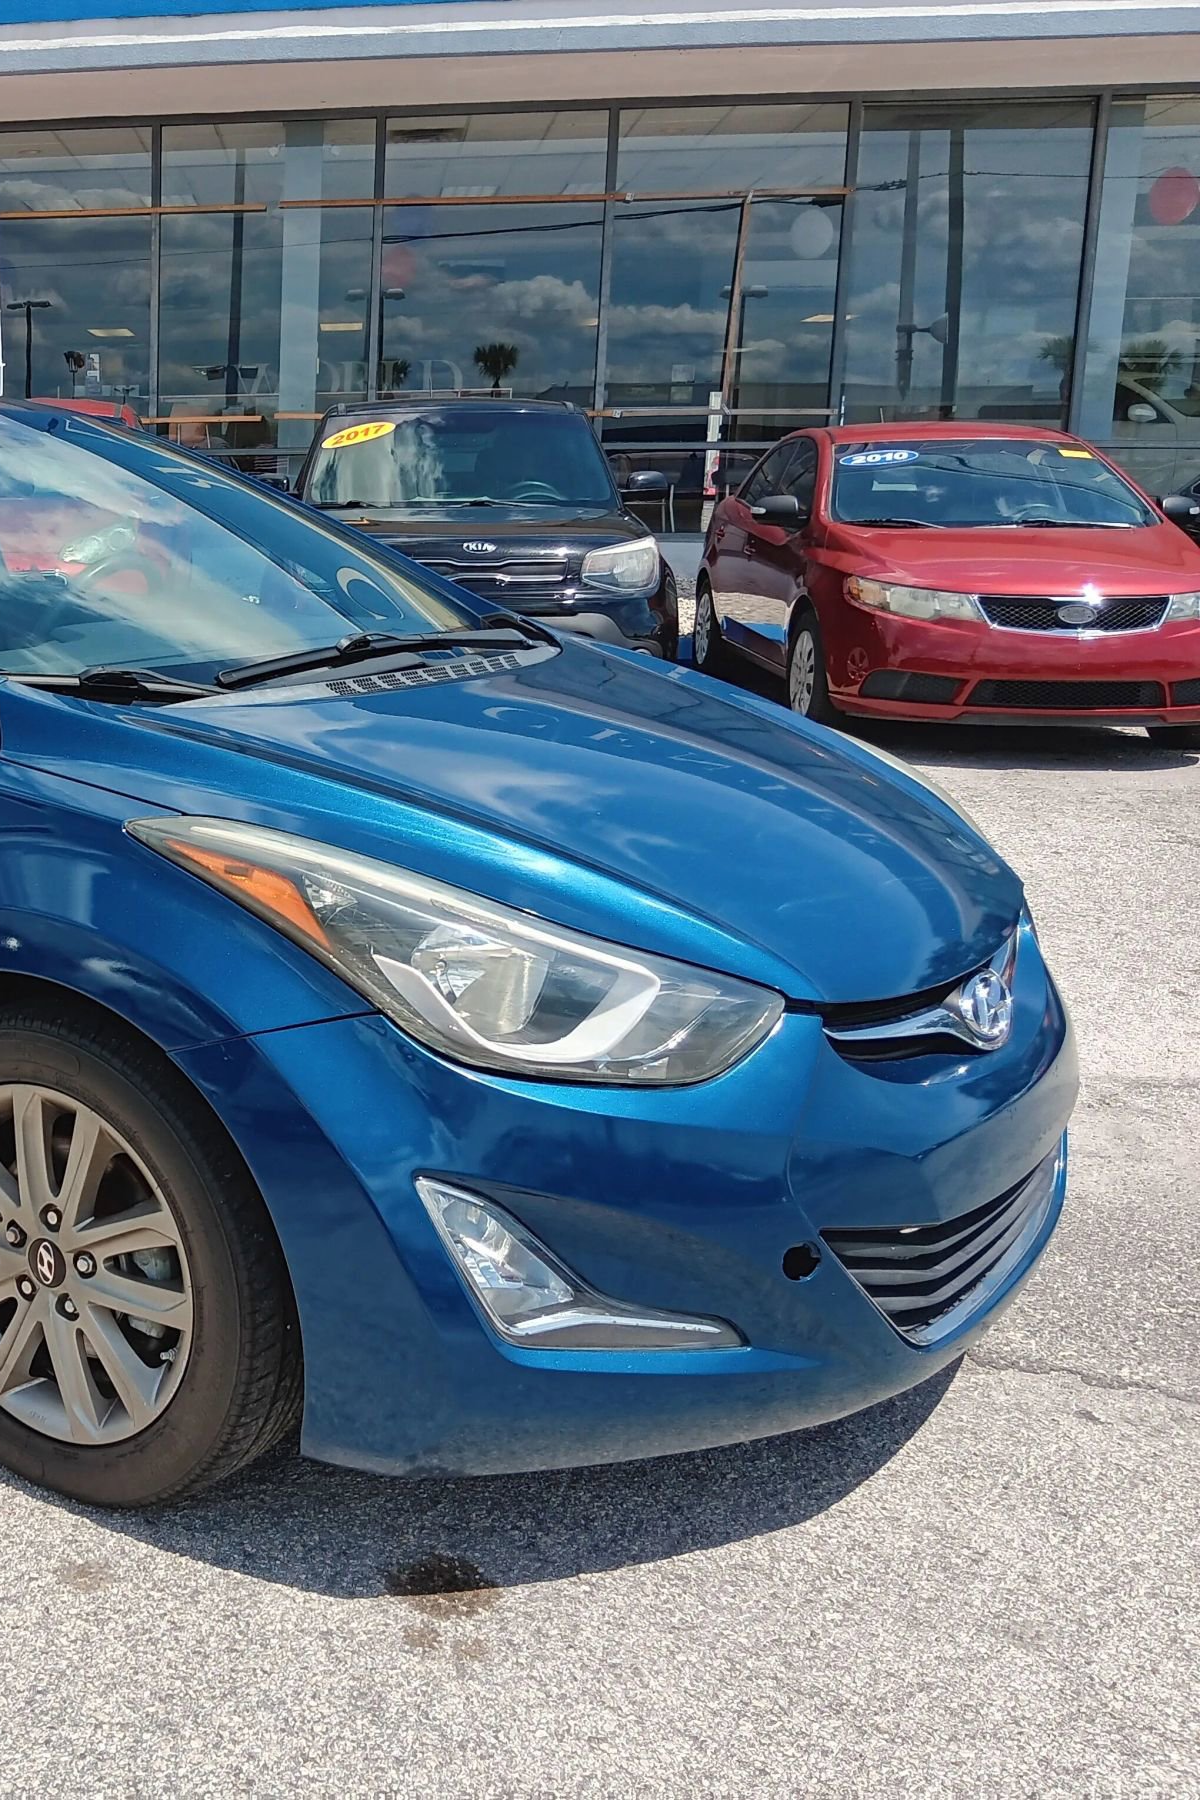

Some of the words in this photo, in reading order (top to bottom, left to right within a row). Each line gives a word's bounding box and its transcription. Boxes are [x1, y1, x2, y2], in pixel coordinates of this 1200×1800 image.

[333, 424, 386, 446] 2017
[851, 452, 909, 465] 2010
[466, 542, 494, 551] KIA
